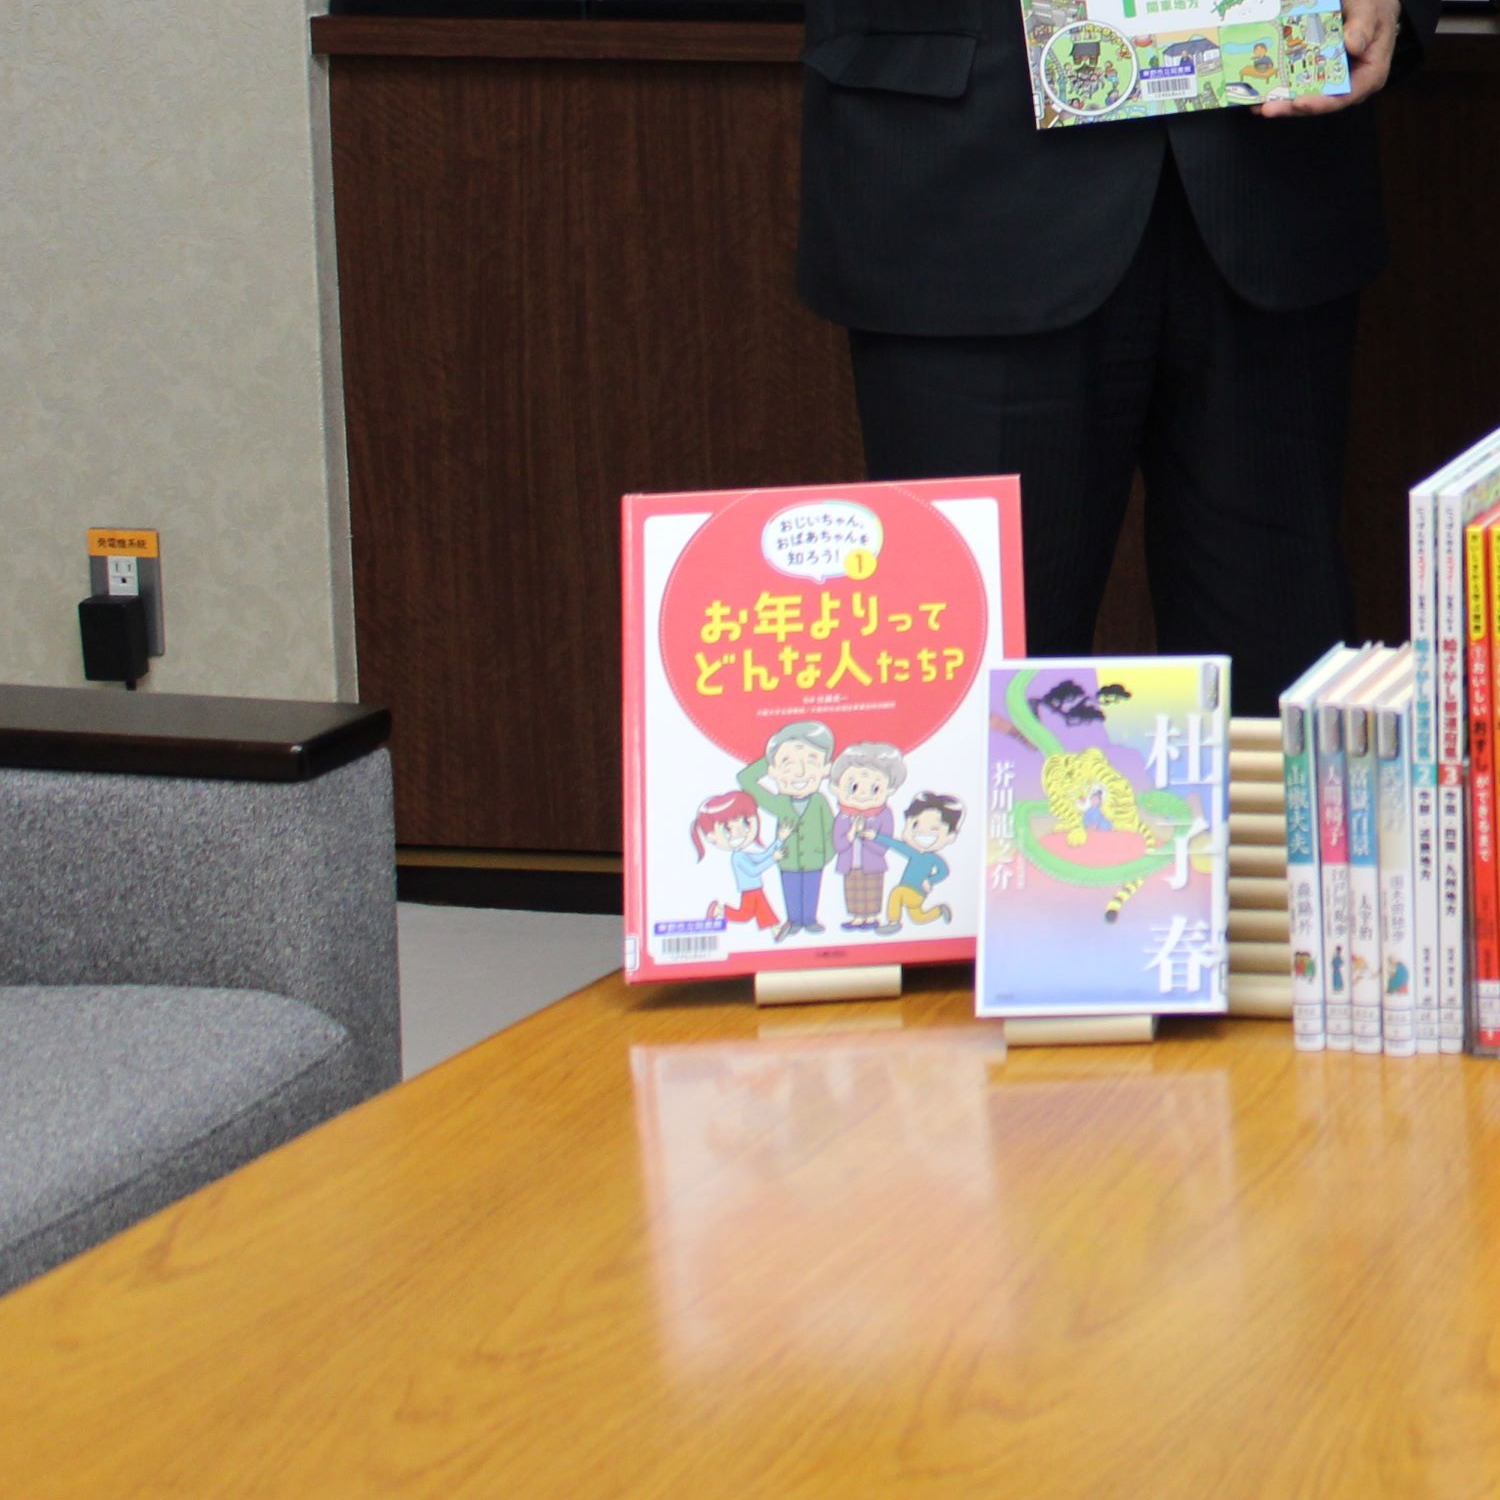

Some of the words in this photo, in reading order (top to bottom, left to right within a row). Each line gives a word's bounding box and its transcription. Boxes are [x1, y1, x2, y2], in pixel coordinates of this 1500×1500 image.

[776, 530, 870, 550] おばあちゃんを
[700, 592, 947, 644] お年よりって
[695, 640, 965, 696] どんな人たち?
[1144, 712, 1217, 993] 杜子春
